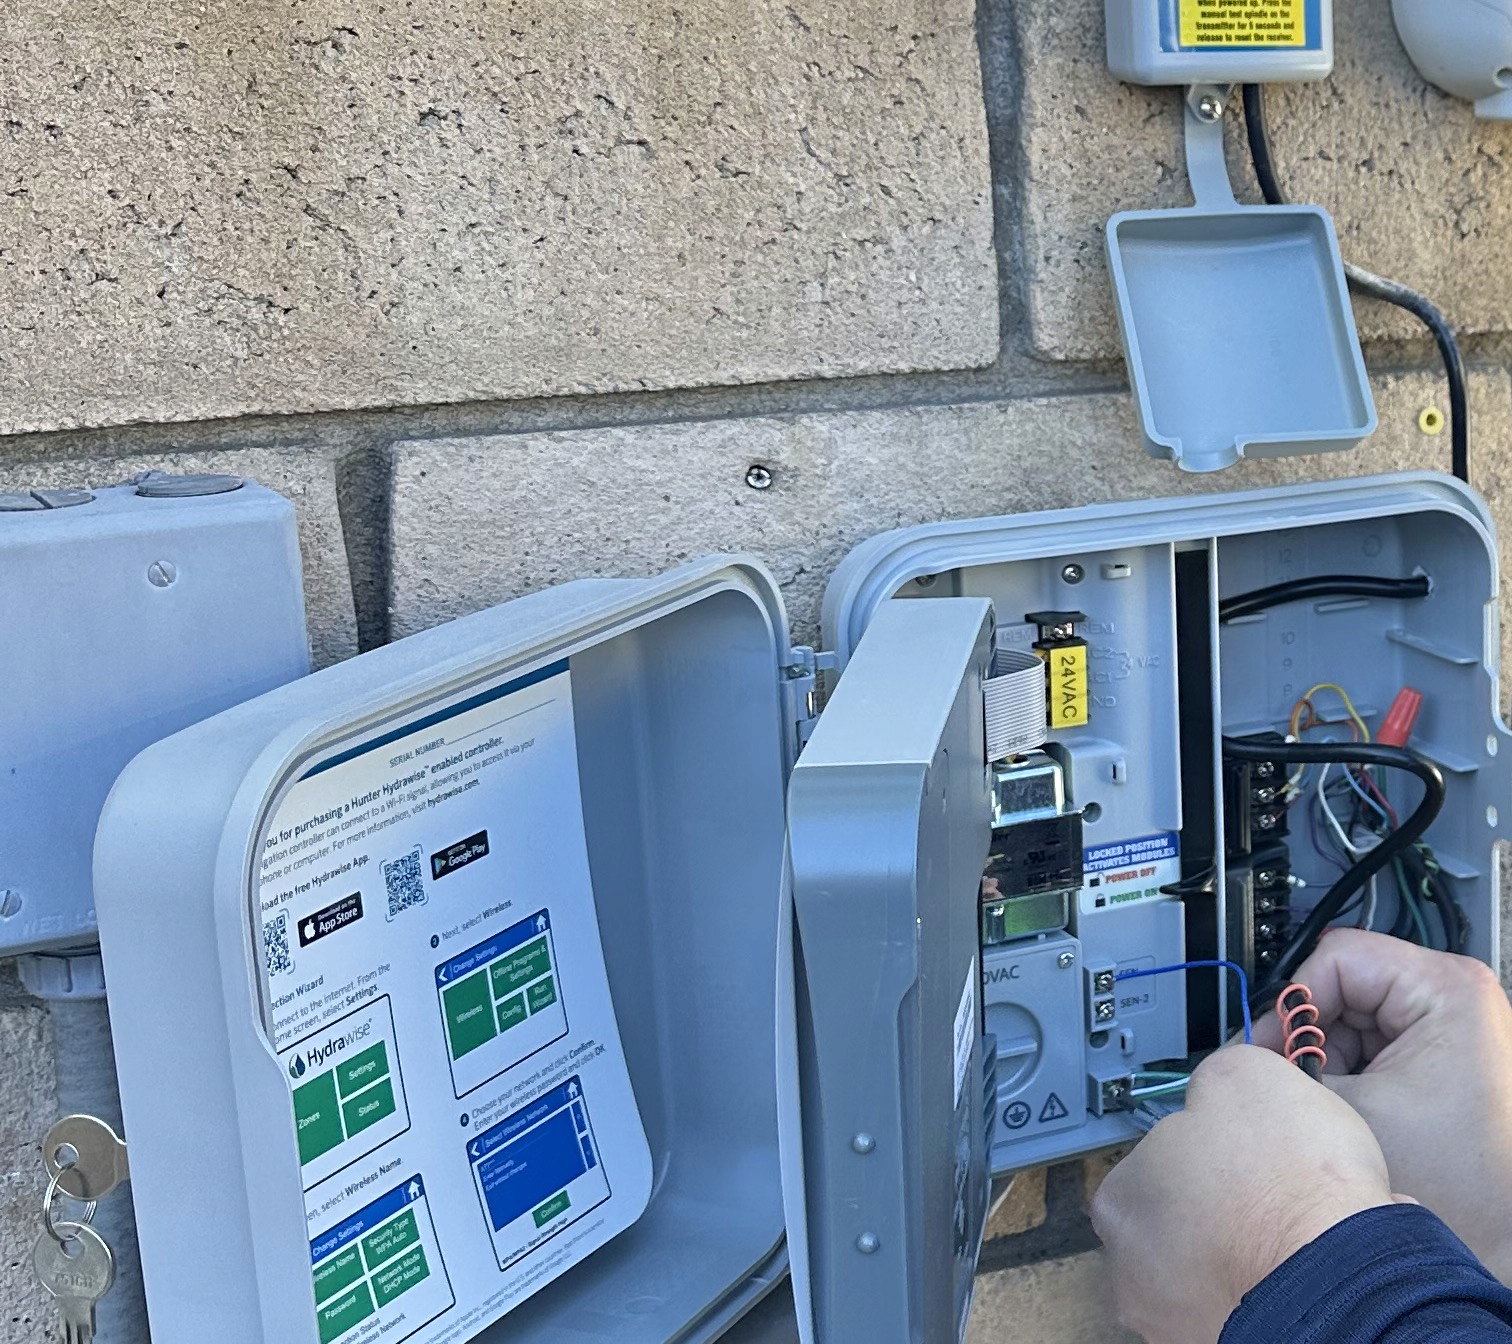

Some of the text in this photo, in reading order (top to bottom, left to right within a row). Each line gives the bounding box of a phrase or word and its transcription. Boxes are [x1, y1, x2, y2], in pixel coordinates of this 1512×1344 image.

[1060, 655, 1078, 719] 24VAC
[280, 829, 292, 843] for
[295, 807, 343, 838] purchasing
[344, 803, 350, 813] a
[351, 788, 381, 810] Hunter
[430, 752, 464, 774] enabled
[289, 830, 326, 855] controller
[326, 825, 340, 837] can
[341, 812, 370, 832] connect
[371, 808, 380, 817] to
[1088, 837, 1169, 861] LOCKED POSITION
[283, 863, 292, 873] or
[332, 840, 345, 852] For
[346, 830, 367, 845] more
[1083, 846, 1176, 872] ACTIVATES MODULES
[280, 889, 294, 903] the
[294, 882, 311, 896] free
[311, 862, 352, 888] Hydrawise
[1105, 870, 1138, 884] POWER
[1110, 890, 1142, 905] POWER
[319, 907, 358, 934] App Store
[295, 975, 324, 997] Wizard
[300, 1007, 309, 1017] to
[310, 999, 323, 1012] the
[357, 970, 378, 986] From
[378, 962, 391, 975] the
[321, 1192, 344, 1212] select
[344, 1171, 379, 1197] Wireless
[312, 1220, 364, 1257] Change Settings
